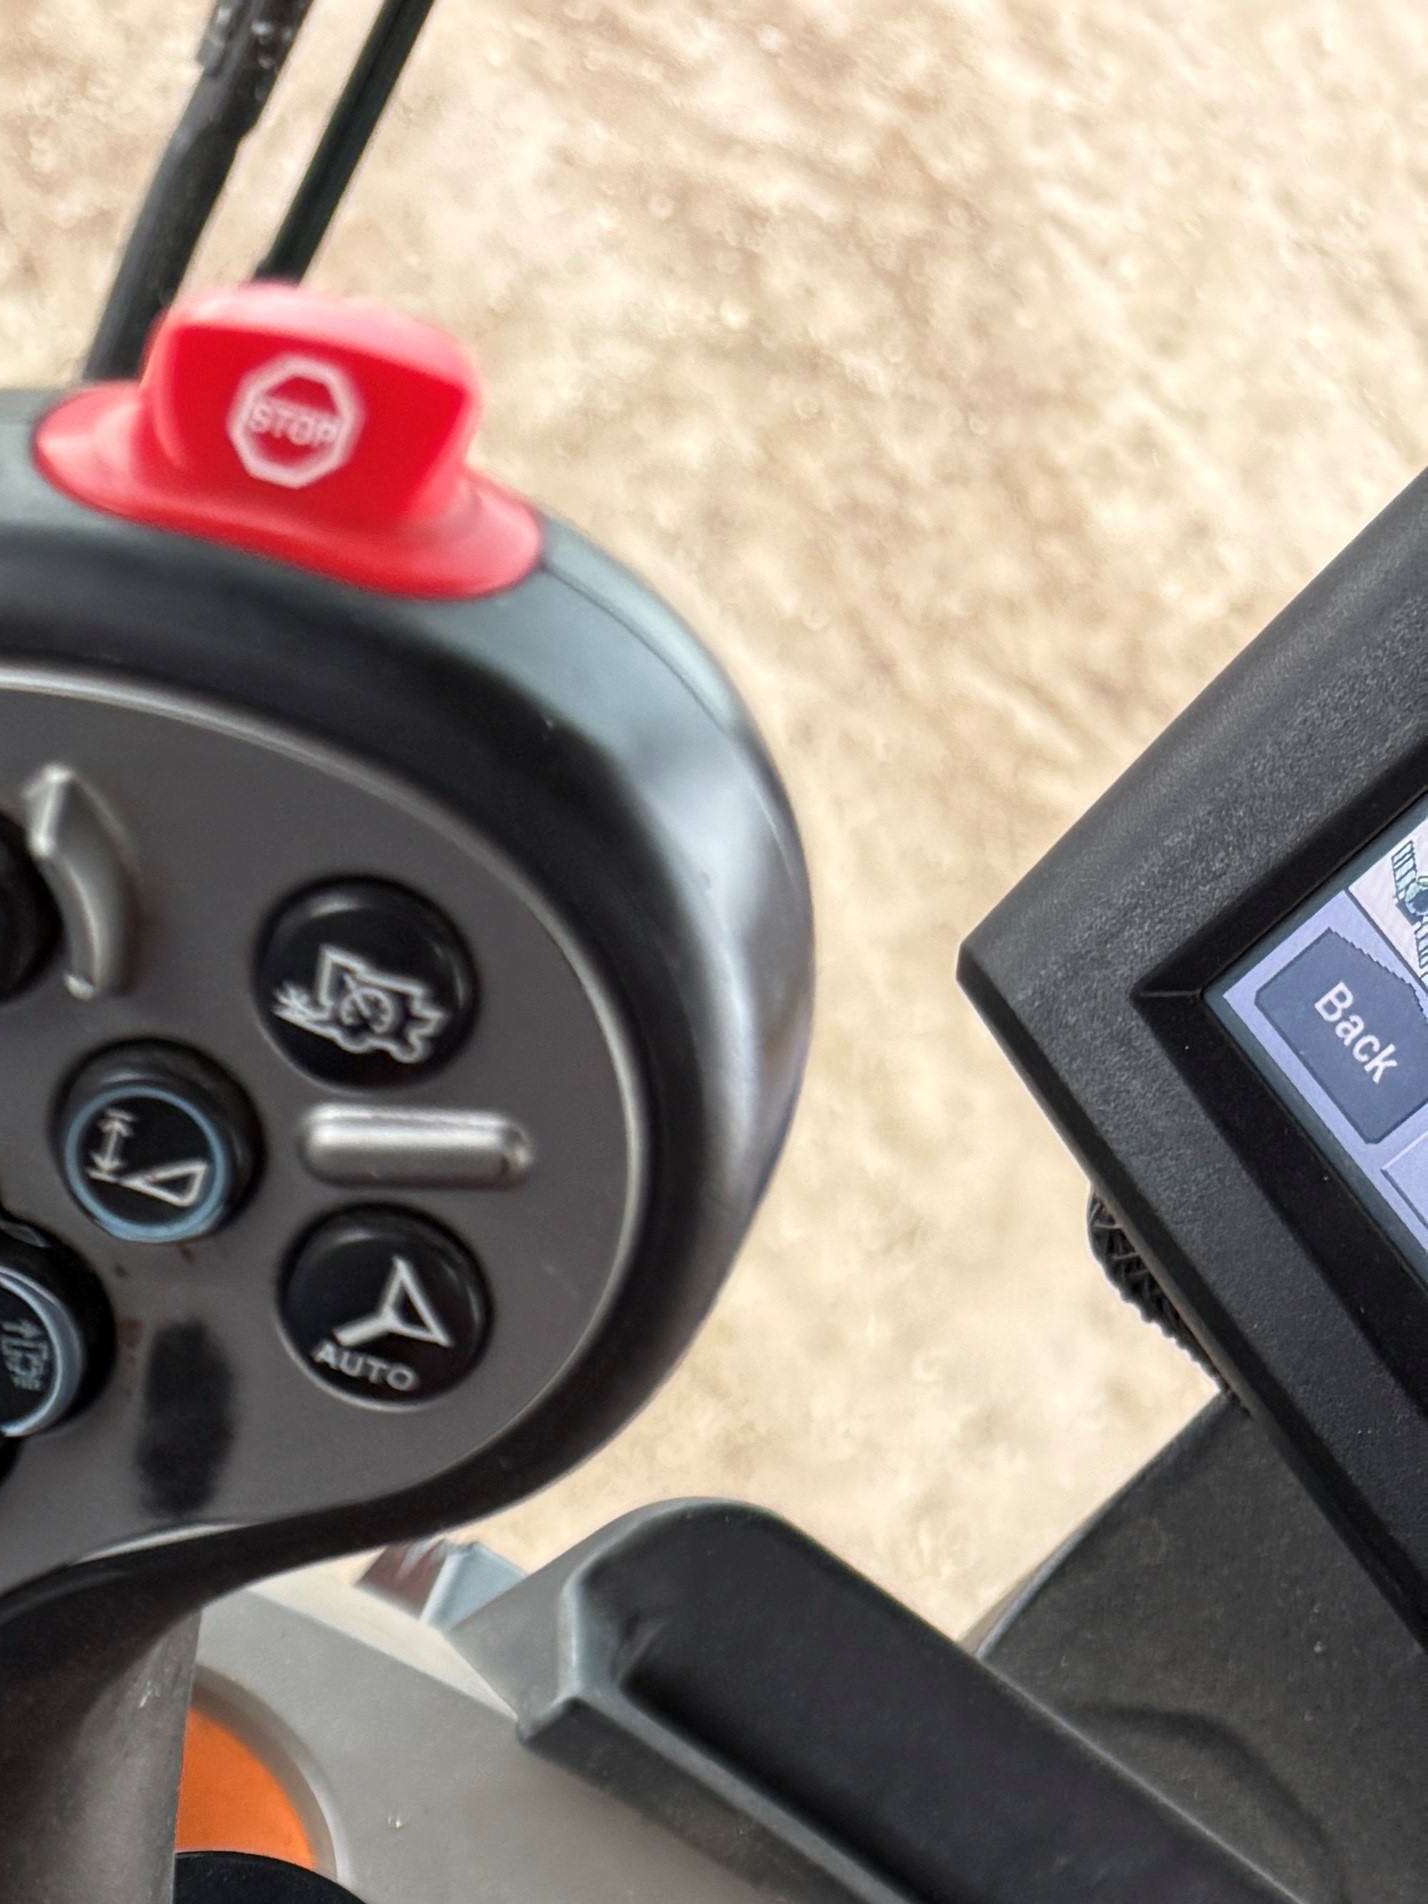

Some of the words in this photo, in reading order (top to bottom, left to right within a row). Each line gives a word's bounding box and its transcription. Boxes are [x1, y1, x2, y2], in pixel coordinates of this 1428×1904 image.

[249, 399, 338, 447] STOP
[1314, 982, 1398, 1084] Back
[312, 1340, 417, 1391] AUTO
